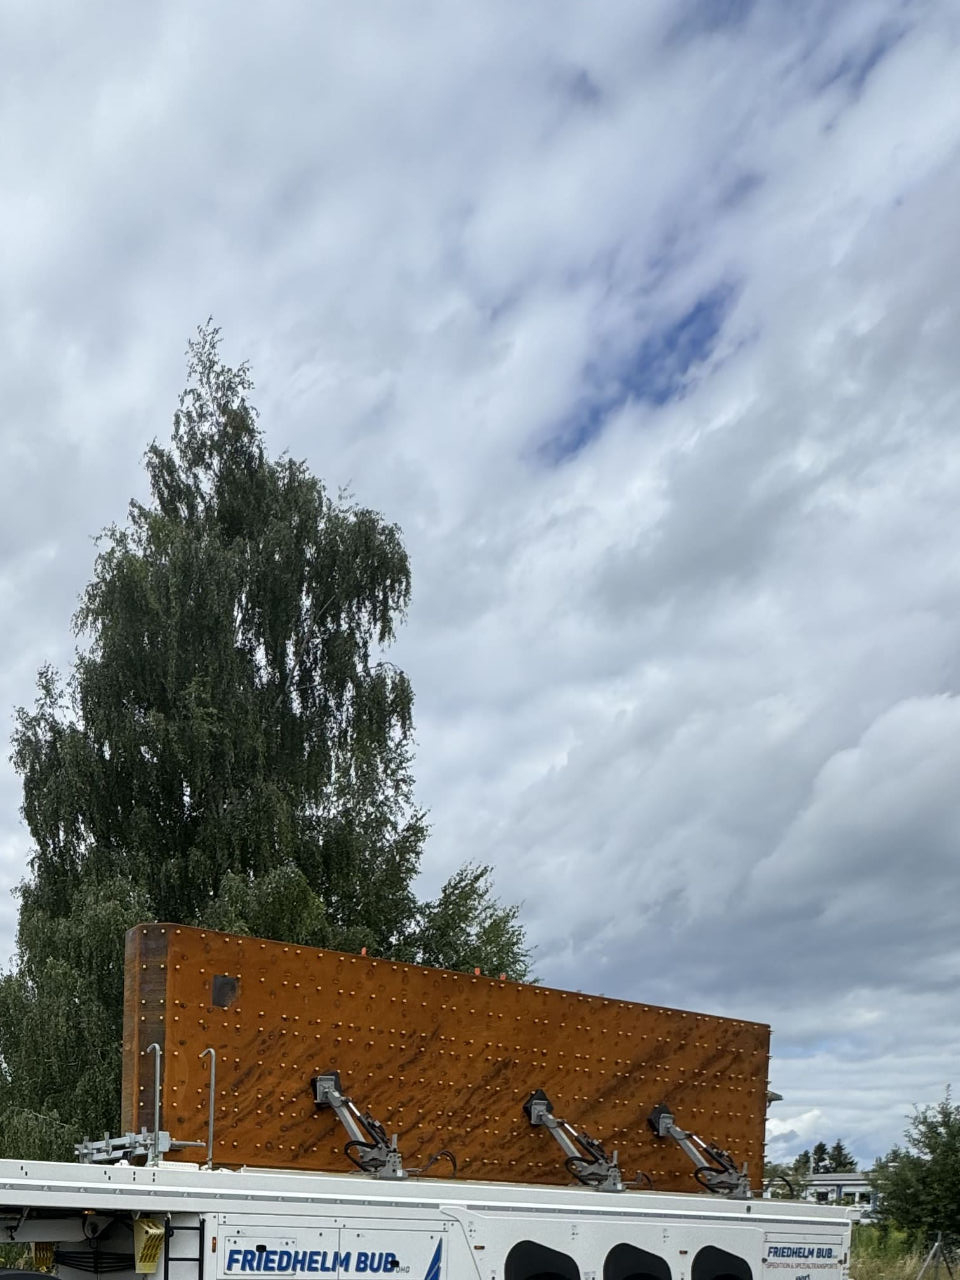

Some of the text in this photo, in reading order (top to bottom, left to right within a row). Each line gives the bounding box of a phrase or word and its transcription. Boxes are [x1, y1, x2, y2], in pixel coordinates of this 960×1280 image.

[226, 1249, 351, 1273] FRIEDHELM
[355, 1252, 398, 1273] BUB
[767, 1246, 814, 1259] FRIEDHELM
[816, 1248, 833, 1259] BUB
